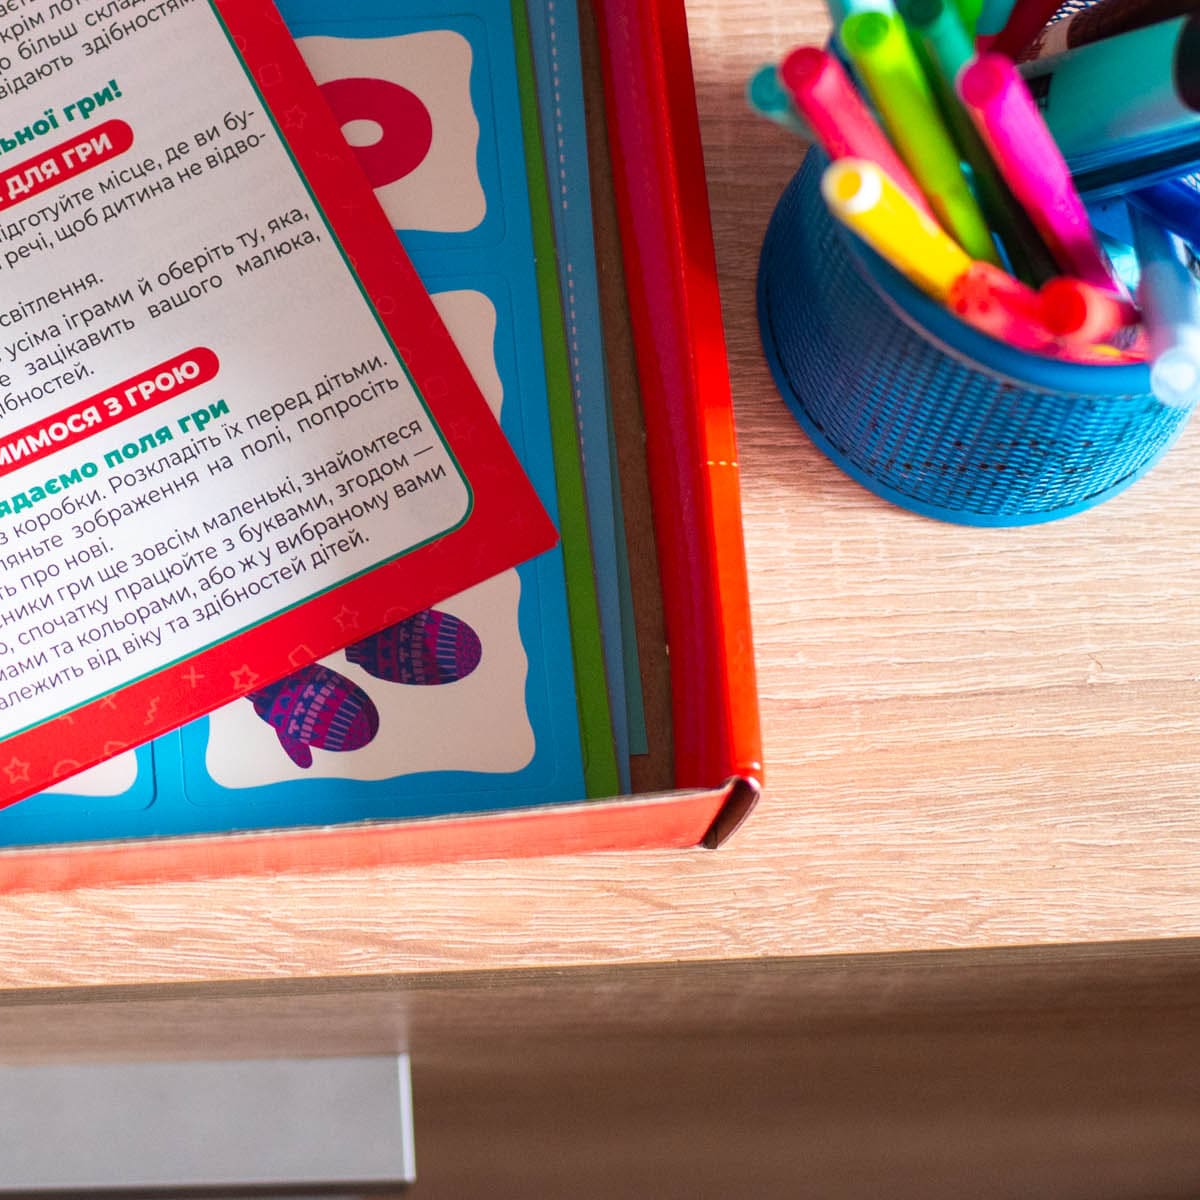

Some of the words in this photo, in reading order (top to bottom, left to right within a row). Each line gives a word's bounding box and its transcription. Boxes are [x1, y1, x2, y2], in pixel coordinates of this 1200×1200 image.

[5, 157, 60, 200] ДЛЯ
[61, 132, 113, 169] ГРИ
[61, 78, 123, 123] гри!
[97, 157, 163, 195] місце,
[164, 140, 191, 166] де
[193, 124, 222, 148] ви
[222, 109, 255, 131] бу-
[3, 230, 55, 270] речі,
[53, 206, 99, 242] щоб
[100, 175, 176, 224] дитина
[175, 161, 204, 184] не
[204, 132, 267, 169] відво-
[3, 323, 62, 363] усіма
[61, 288, 135, 331] іграми
[136, 276, 154, 297] й
[156, 243, 235, 287] оберіть
[235, 227, 266, 249] ту,
[266, 207, 310, 235] яка,
[23, 318, 136, 376] зацікавить
[146, 274, 223, 319] вашого
[234, 229, 321, 277] малюка,
[11, 488, 108, 539] коробки.
[107, 434, 222, 495] Розкладіть
[220, 421, 245, 440] їх
[245, 389, 314, 430] перед
[313, 354, 388, 401] дітьми.
[102, 396, 123, 417] З
[124, 360, 200, 407] ГРОЮ
[102, 424, 175, 469] поля
[176, 398, 231, 435] гри
[55, 574, 96, 601] гри
[96, 559, 129, 583] ще
[130, 525, 201, 567] зовсім
[201, 479, 303, 535] маленькі,
[300, 419, 423, 487] знайомтеся
[70, 470, 200, 539] зображення
[206, 454, 234, 477] на
[239, 424, 292, 460] полі,
[296, 377, 400, 433] попросіть
[19, 562, 61, 590] про
[62, 535, 115, 571] нові.
[86, 646, 122, 671] від
[121, 625, 162, 655] віку
[163, 615, 191, 634] та
[191, 555, 308, 623] здібностей
[309, 527, 370, 570] дітей.
